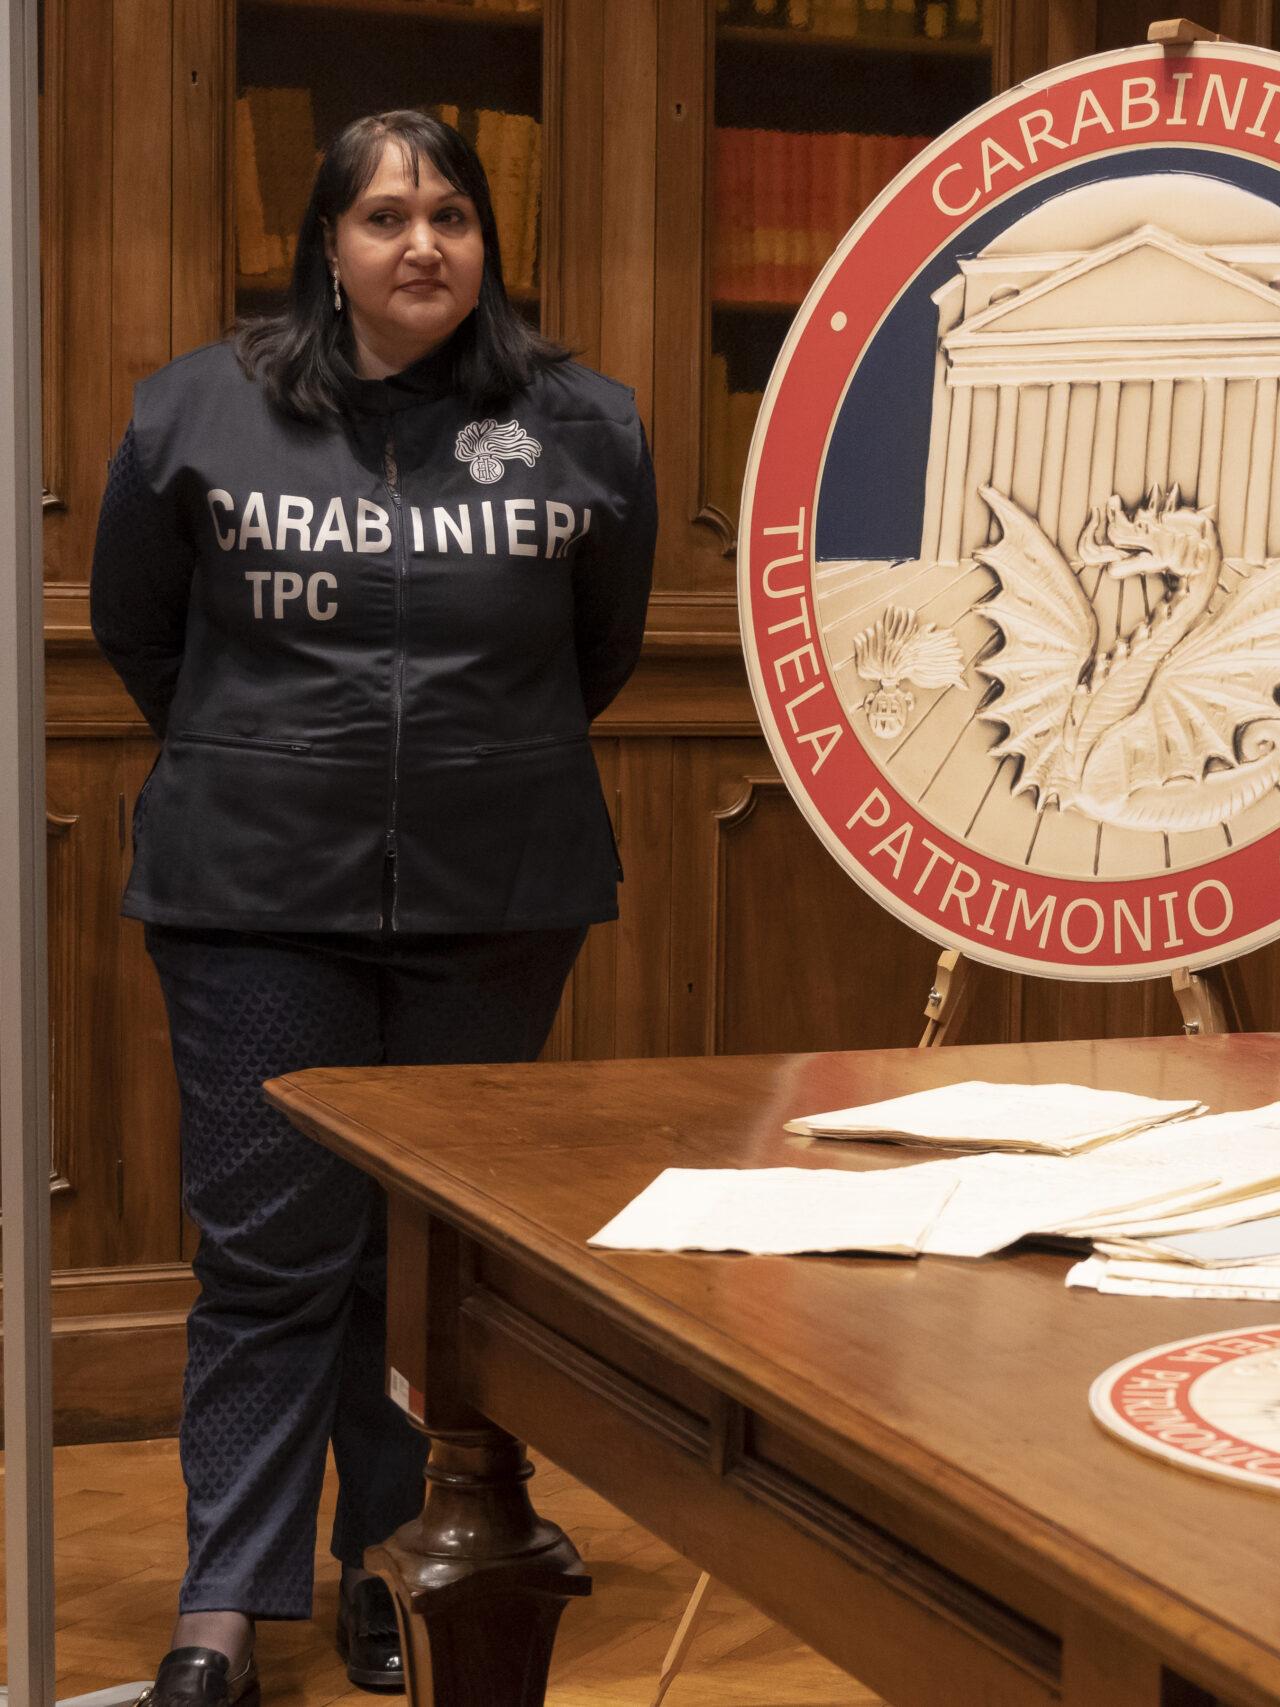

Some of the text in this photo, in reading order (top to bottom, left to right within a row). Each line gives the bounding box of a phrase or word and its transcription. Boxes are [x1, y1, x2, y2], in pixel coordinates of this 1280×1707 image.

[207, 488, 592, 559] CARABINIERI
[245, 571, 338, 621] TPC
[762, 506, 844, 776] TUTELA
[845, 786, 1234, 954] PATRIMONIO
